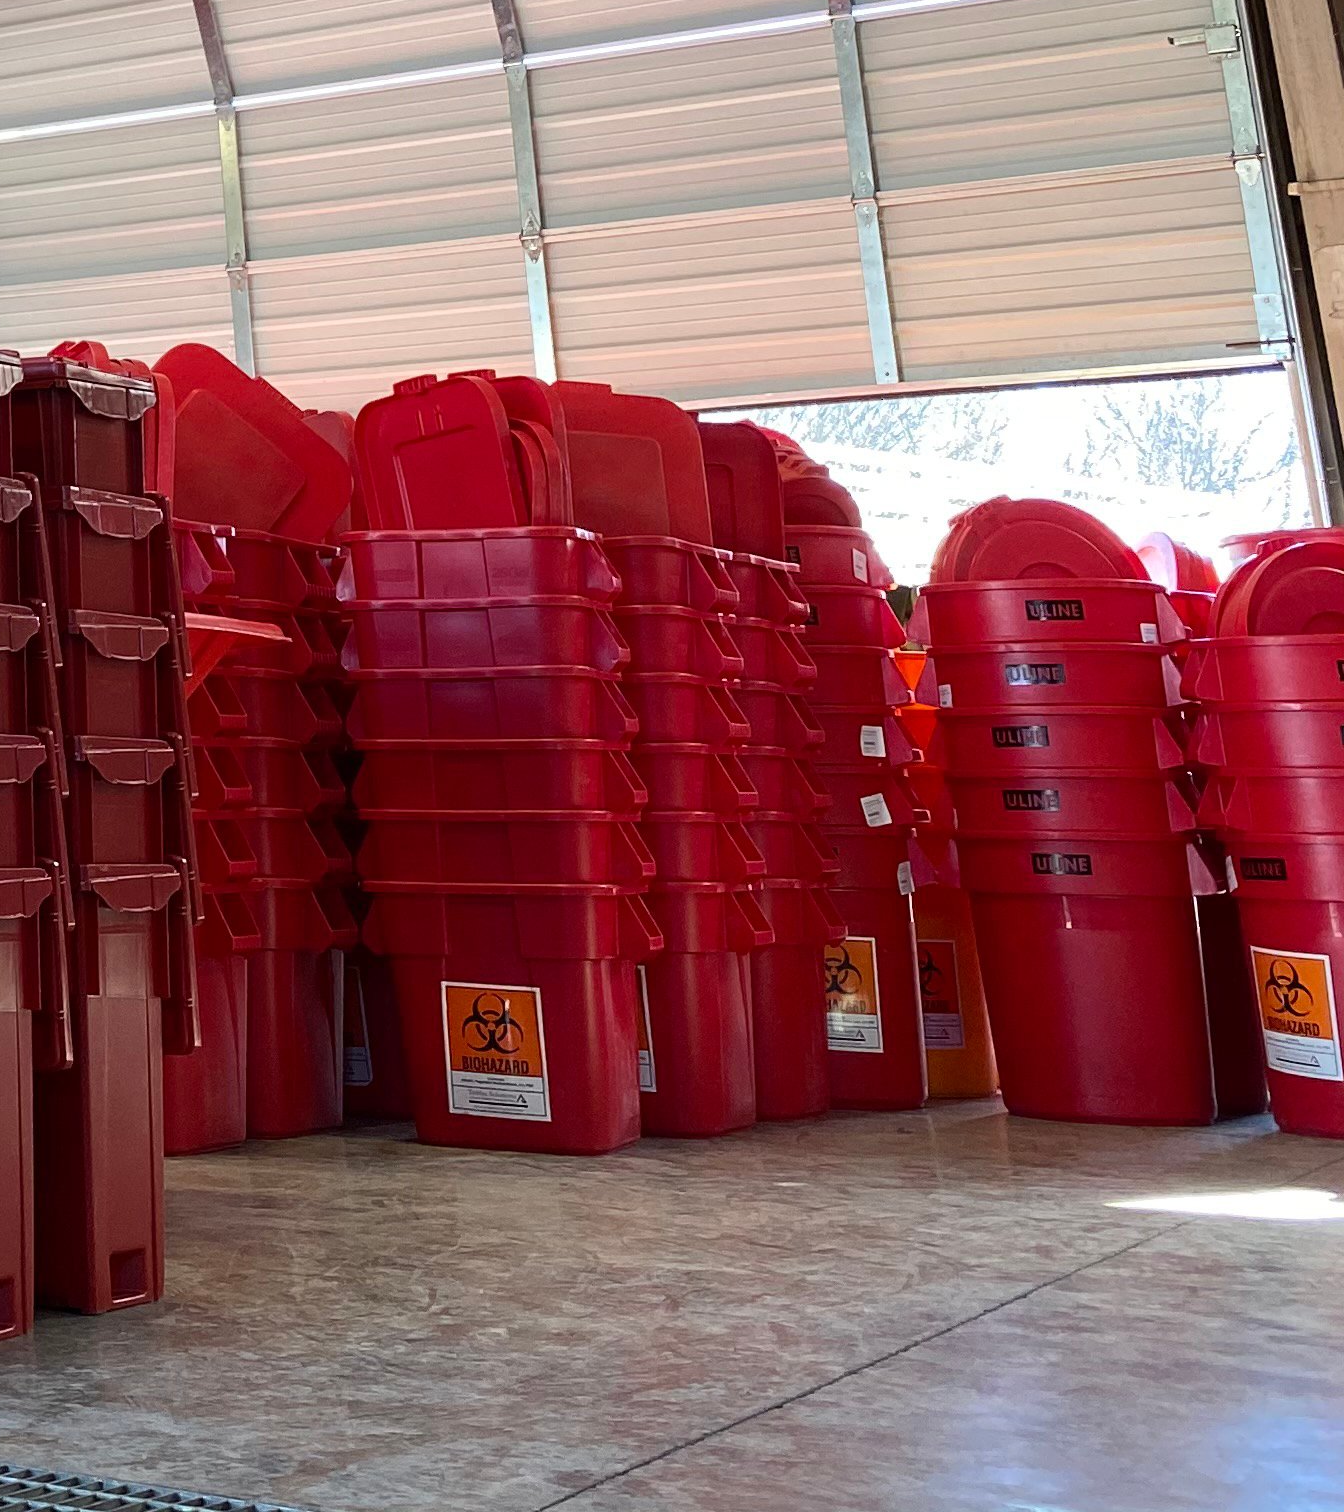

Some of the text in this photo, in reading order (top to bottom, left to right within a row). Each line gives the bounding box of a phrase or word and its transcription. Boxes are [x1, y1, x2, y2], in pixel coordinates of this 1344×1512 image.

[1028, 603, 1081, 617] ULINE
[1010, 666, 1062, 681] ULINE
[1006, 793, 1057, 808] ULINE
[1036, 856, 1088, 872] ULINE
[827, 998, 867, 1013] HAZARD
[1266, 1016, 1320, 1037] BIOHAZARD
[462, 1055, 529, 1075] BIOHAZARD
